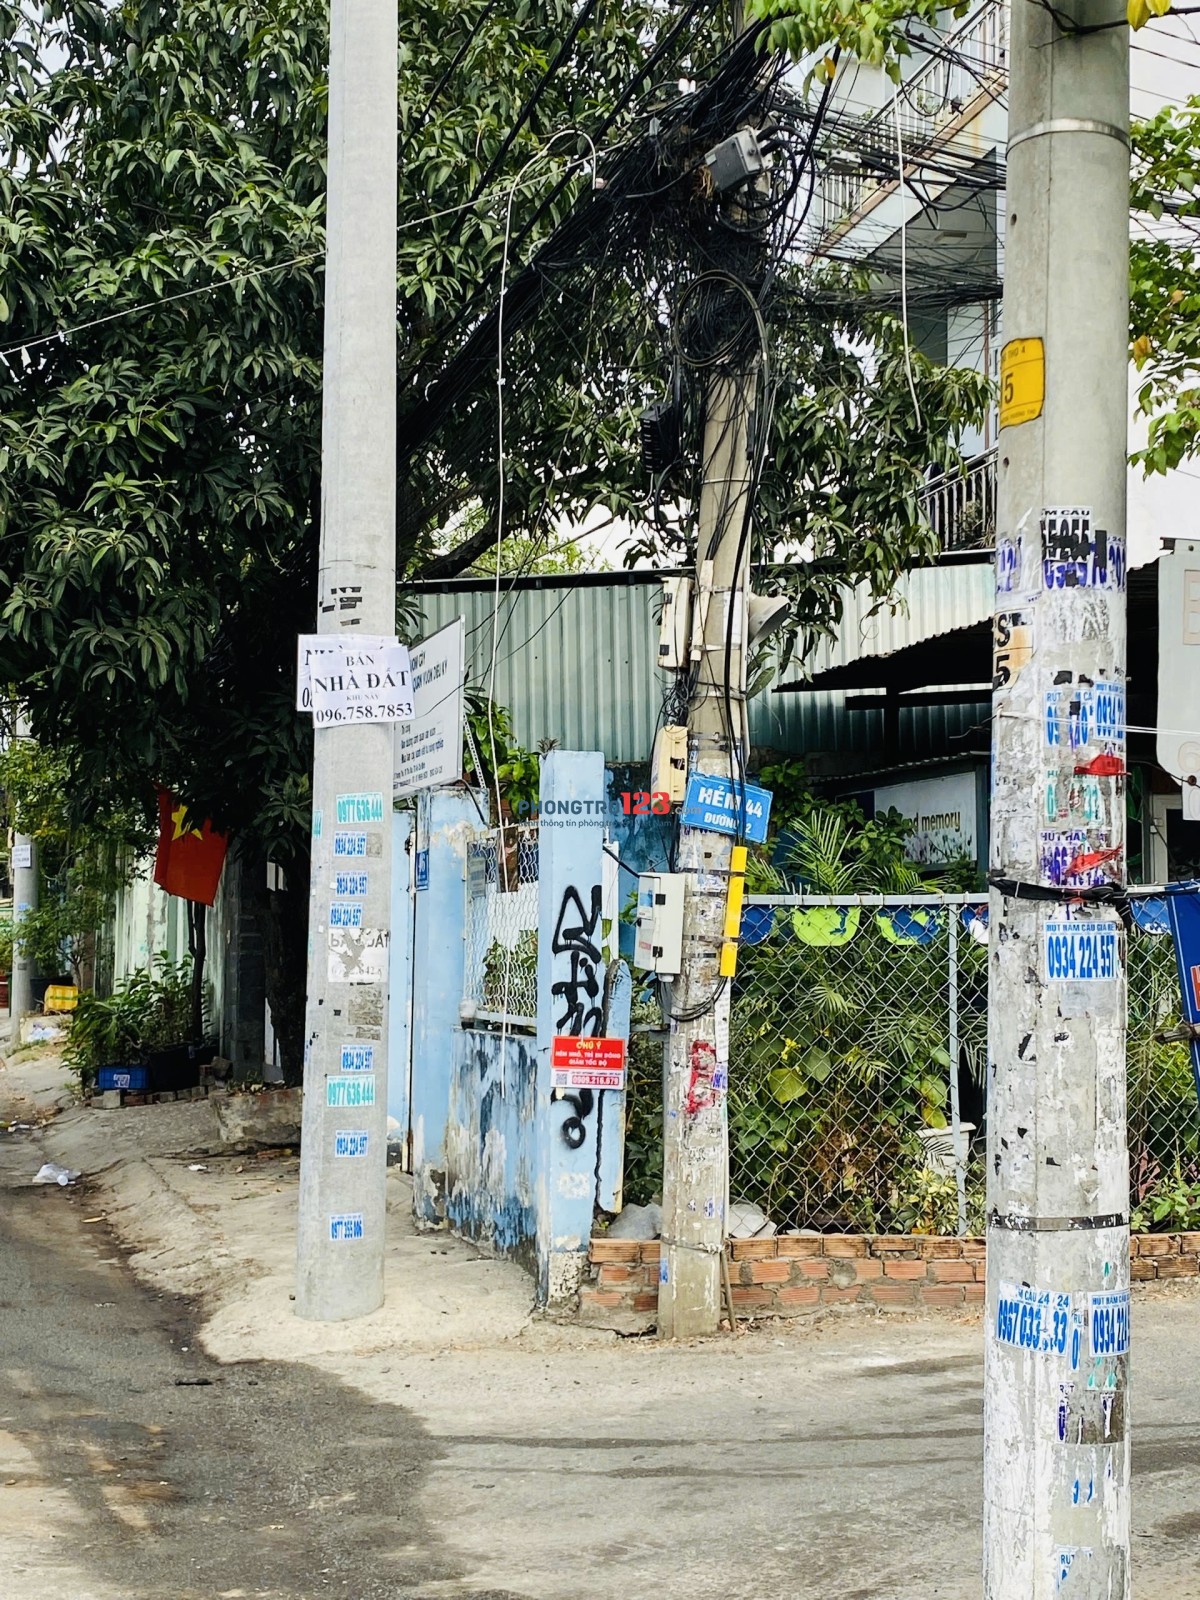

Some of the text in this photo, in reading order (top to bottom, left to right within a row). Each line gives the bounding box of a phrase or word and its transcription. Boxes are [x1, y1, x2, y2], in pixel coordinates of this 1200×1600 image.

[1004, 372, 1014, 405] 5
[346, 652, 375, 667] BÁN
[314, 667, 409, 693] NHÀ ĐẤT
[316, 703, 413, 723] 096.758.7853
[698, 785, 763, 818] HẺM 44
[745, 823, 752, 834] 2
[921, 811, 960, 832] memory
[1081, 924, 1096, 932] CAU
[1048, 935, 1115, 979] 0934.224.557
[576, 1040, 602, 1050] CHÚ Ý
